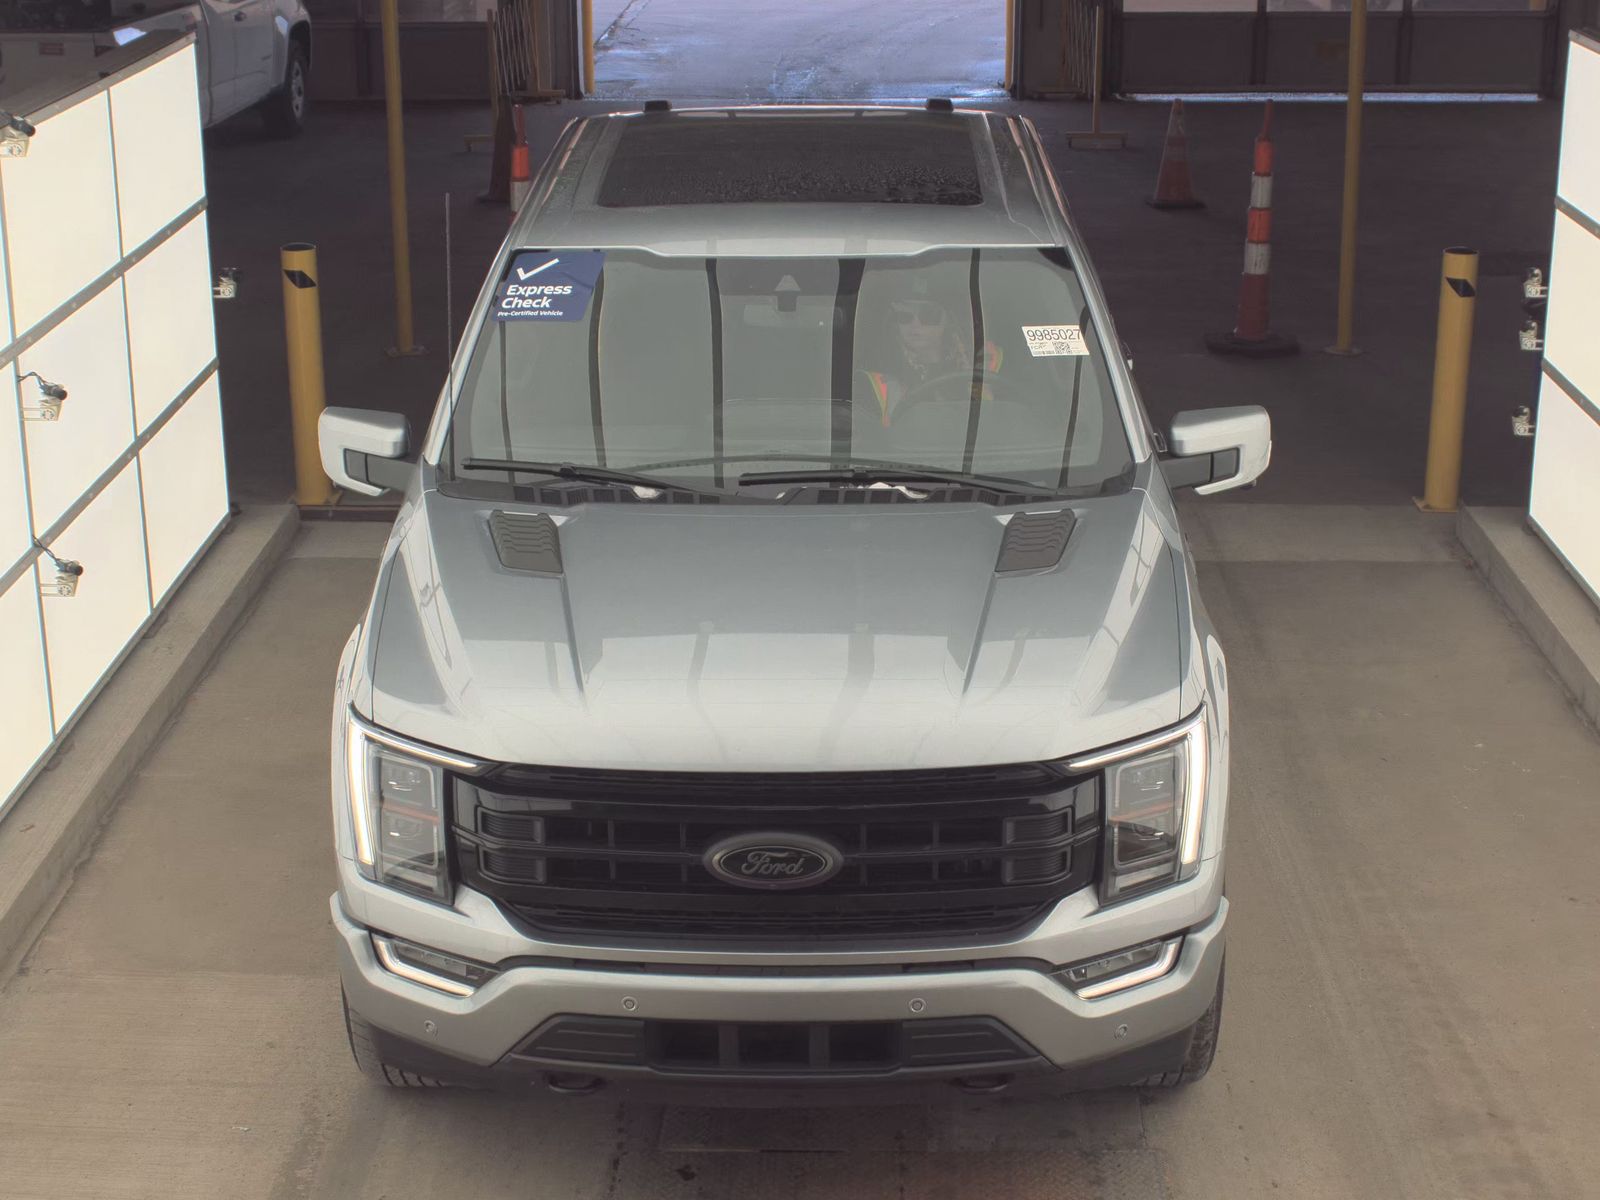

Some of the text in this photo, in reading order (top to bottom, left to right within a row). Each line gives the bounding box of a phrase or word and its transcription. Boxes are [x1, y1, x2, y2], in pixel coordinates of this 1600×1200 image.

[506, 285, 573, 297] Express
[502, 296, 552, 308] Check
[1027, 328, 1081, 342] 9985027
[741, 851, 805, 875] Ford
